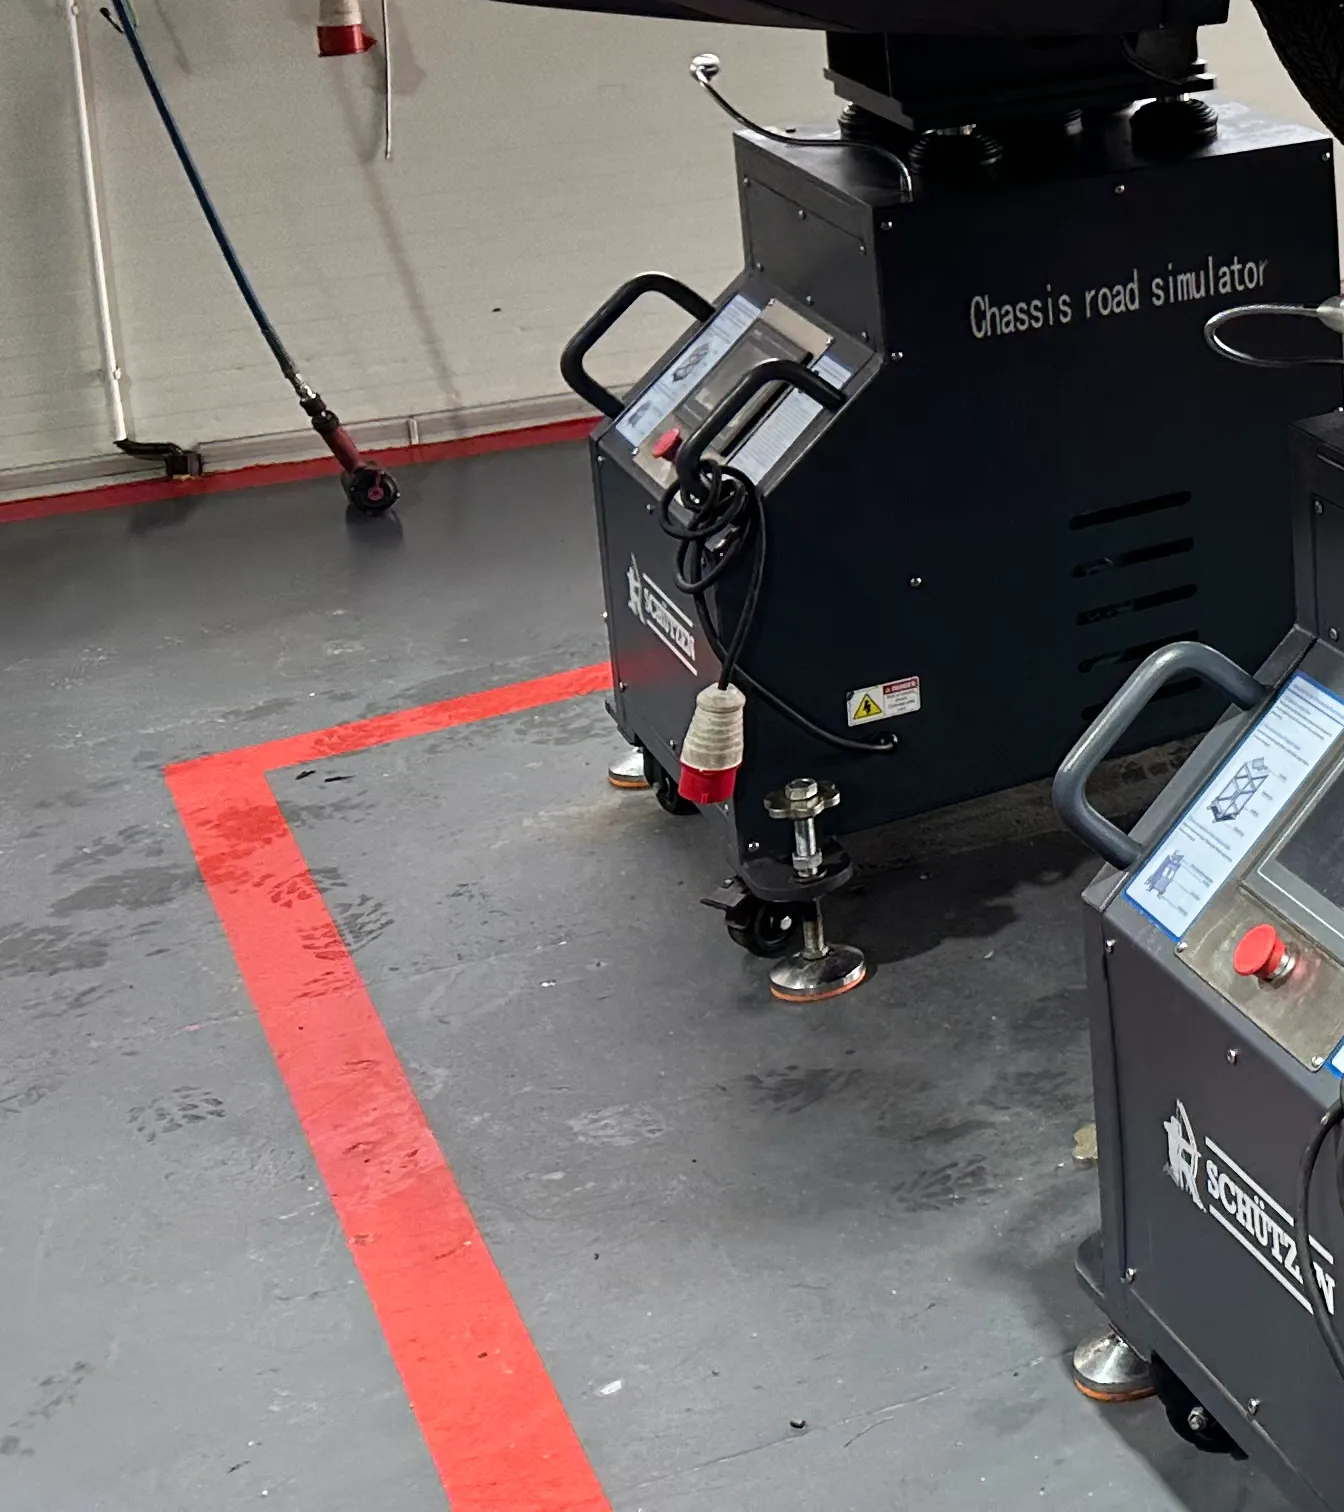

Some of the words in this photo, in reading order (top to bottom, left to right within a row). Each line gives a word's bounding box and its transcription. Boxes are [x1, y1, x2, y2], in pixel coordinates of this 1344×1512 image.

[970, 284, 1072, 338] Chassis
[1085, 268, 1139, 319] road
[1152, 256, 1268, 307] simulator
[1206, 1159, 1335, 1315] SCHÜTZN
